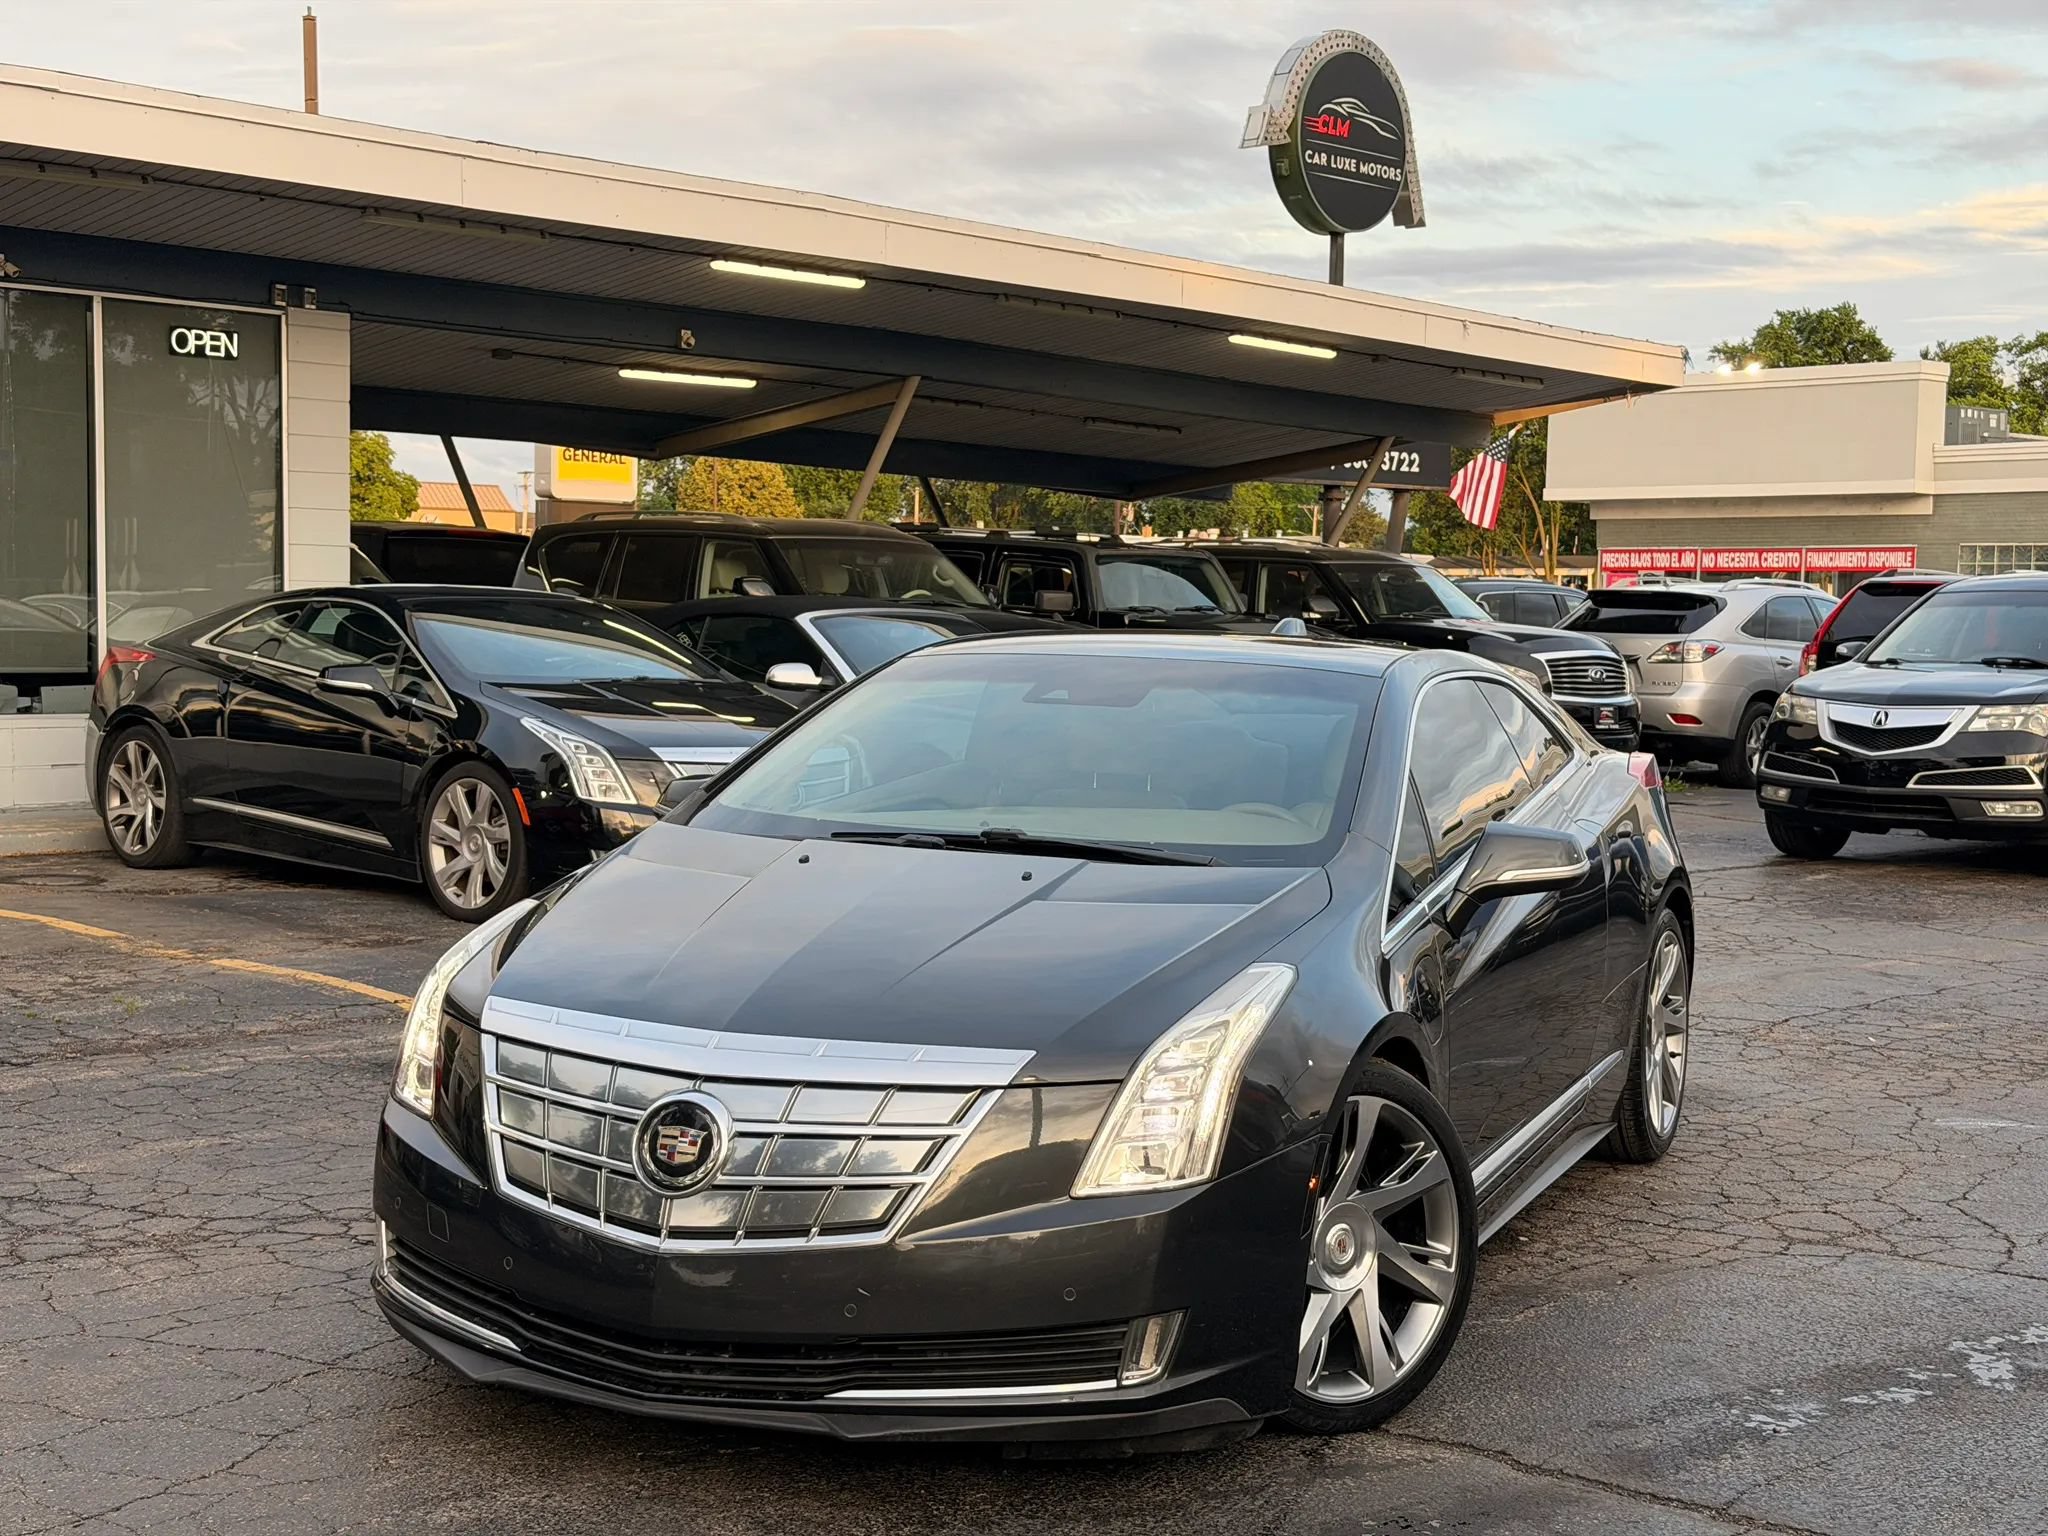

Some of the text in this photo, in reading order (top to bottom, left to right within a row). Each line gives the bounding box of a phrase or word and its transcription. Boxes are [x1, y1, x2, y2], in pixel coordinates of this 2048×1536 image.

[1318, 114, 1351, 138] CLM
[1305, 150, 1402, 182] CAR LUXE MOTORS
[171, 328, 238, 357] OPEN
[563, 448, 626, 464] GENERAL
[1602, 551, 1695, 568] PRECIOS BAJOS TODO EL AÑO
[1702, 552, 1800, 568] NO NECESITA CREDITO
[1806, 551, 1912, 568] FINANCIAMIENTO DISPONIBLE
